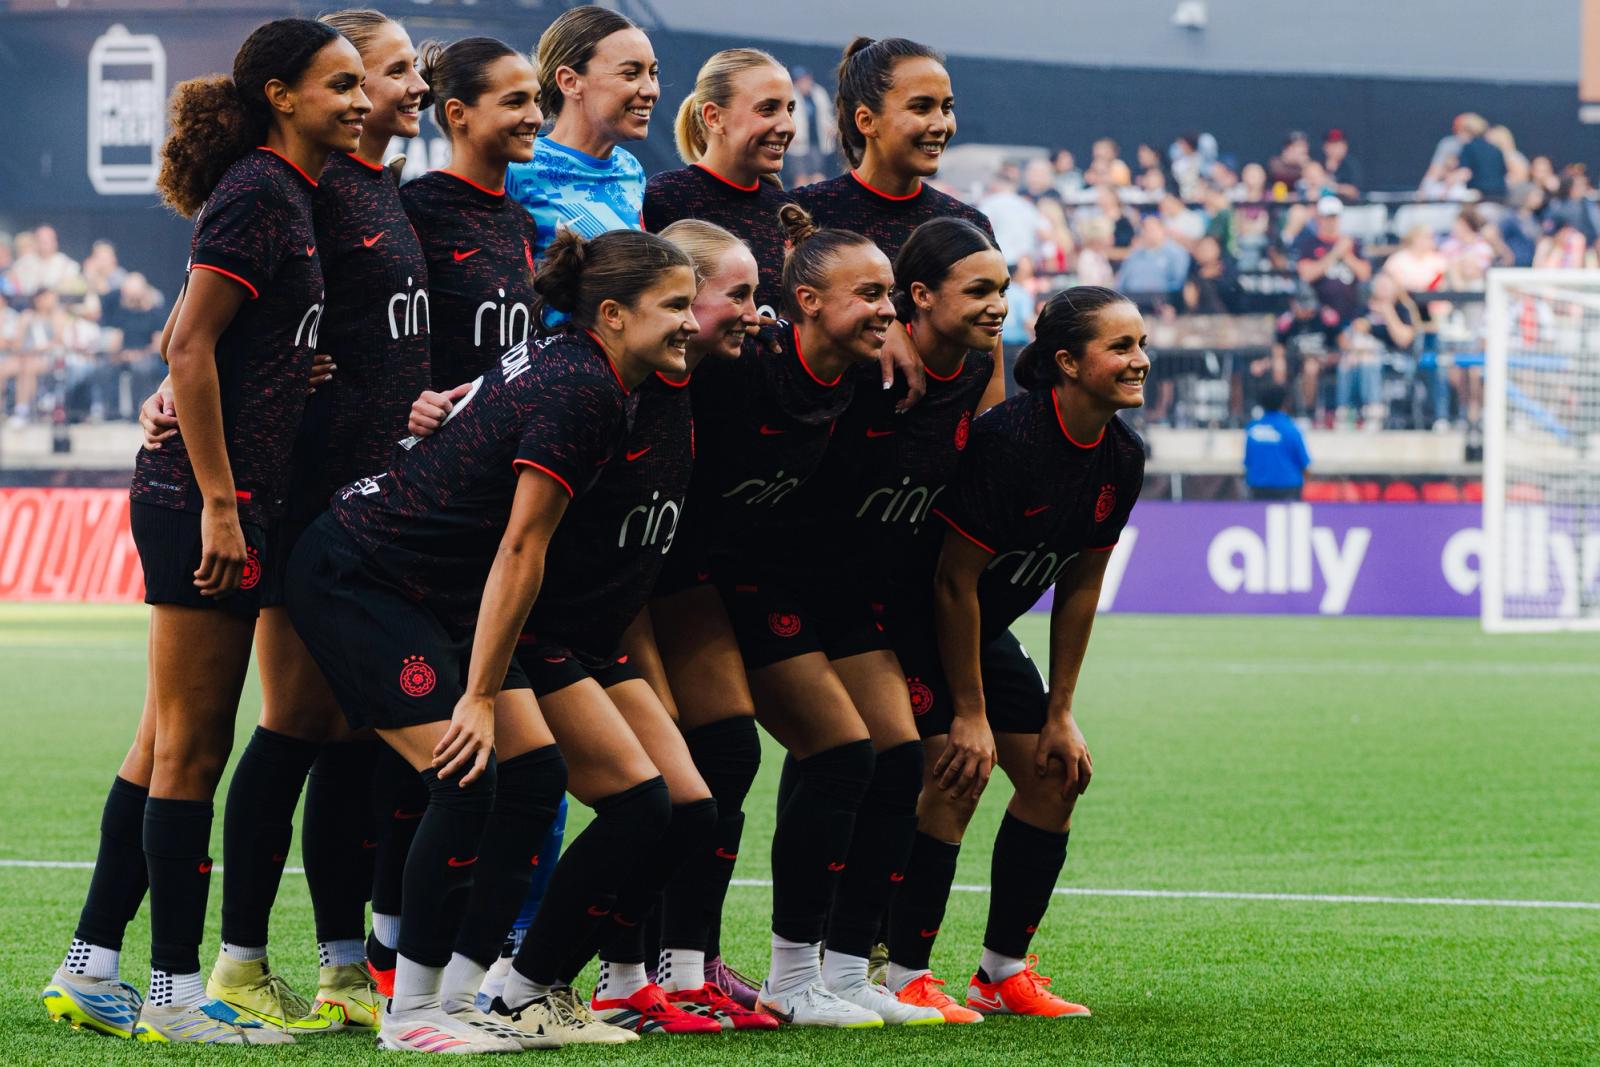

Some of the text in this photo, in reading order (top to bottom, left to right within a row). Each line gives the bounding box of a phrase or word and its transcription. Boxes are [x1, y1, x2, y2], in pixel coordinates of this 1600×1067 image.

[474, 288, 530, 346] rin
[721, 469, 800, 507] rin
[1207, 504, 1372, 614] ally
[1441, 506, 1600, 616] ally
